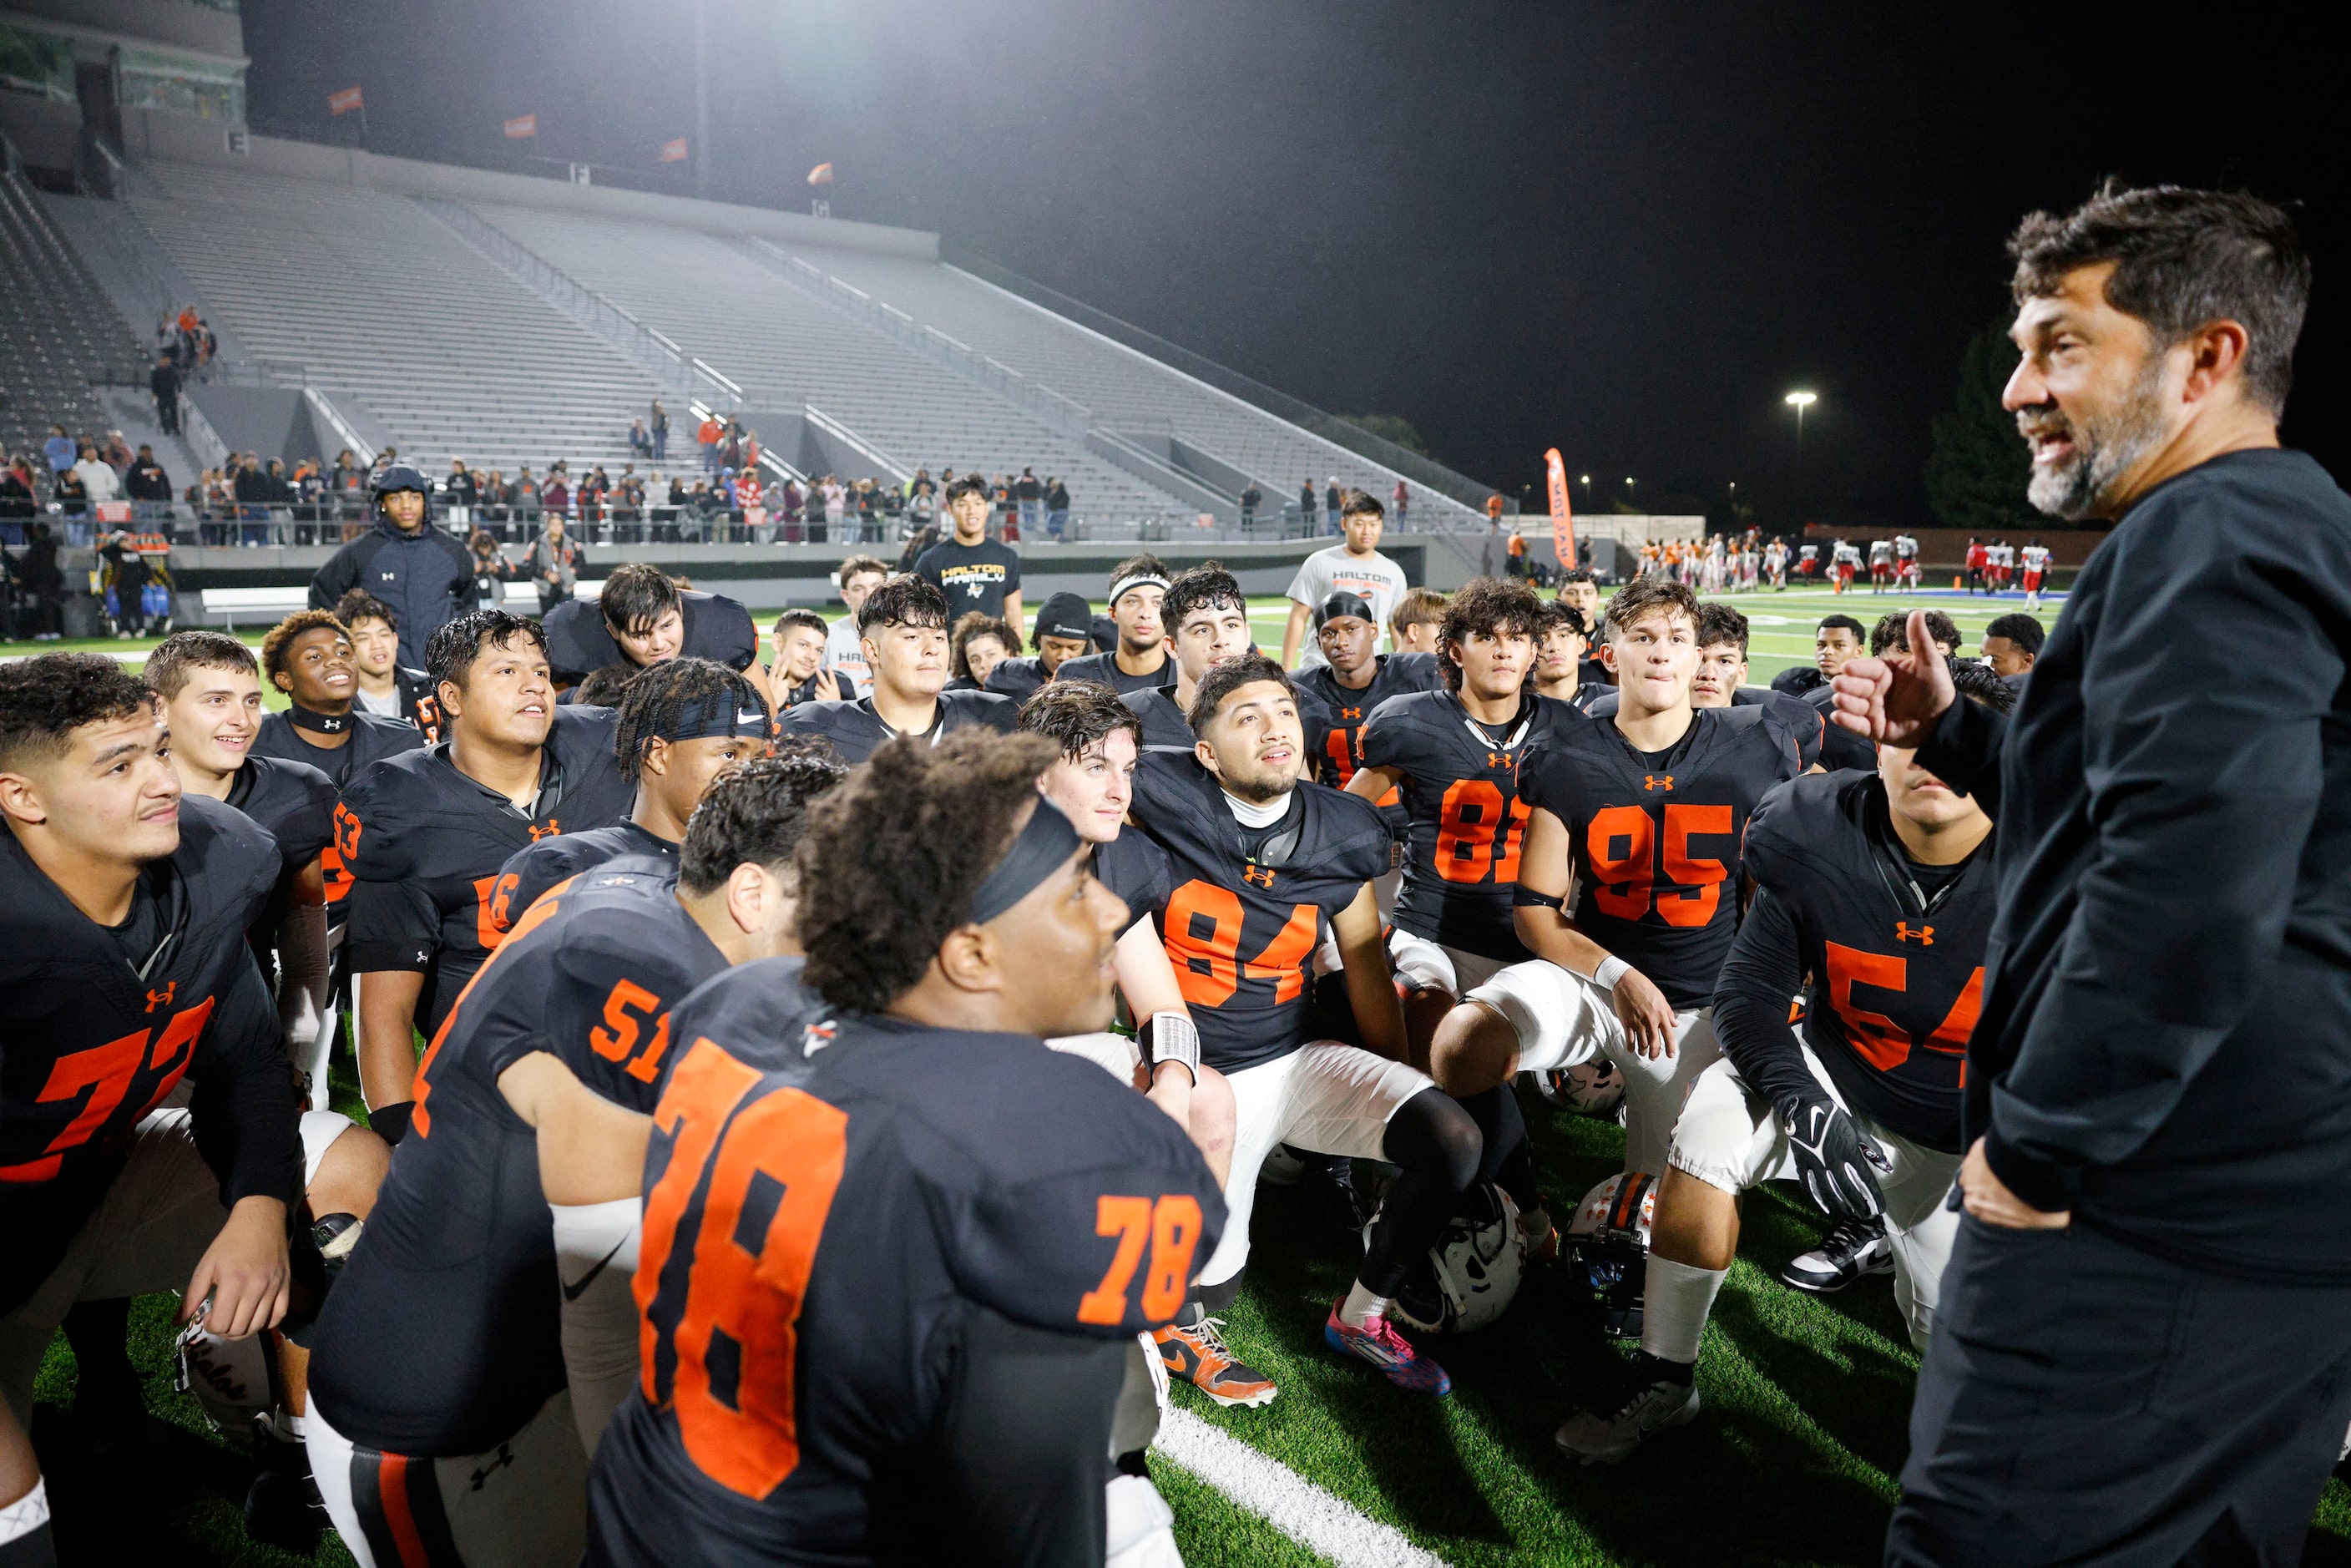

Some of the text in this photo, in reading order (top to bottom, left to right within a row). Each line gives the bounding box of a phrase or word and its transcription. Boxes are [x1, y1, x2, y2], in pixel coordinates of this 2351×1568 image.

[228, 133, 245, 152] E
[941, 564, 1006, 579] HALTOM
[942, 573, 1006, 587] FAMILY
[1332, 579, 1390, 593] FOOTBALL
[1333, 571, 1392, 585] HALTOM
[839, 652, 867, 662] HAL
[1434, 779, 1532, 884] 81
[1587, 803, 1733, 928] 95
[1164, 878, 1319, 1008] 84
[589, 979, 670, 1084] 51
[631, 1036, 848, 1500] 78
[1077, 1194, 1204, 1325] 78
